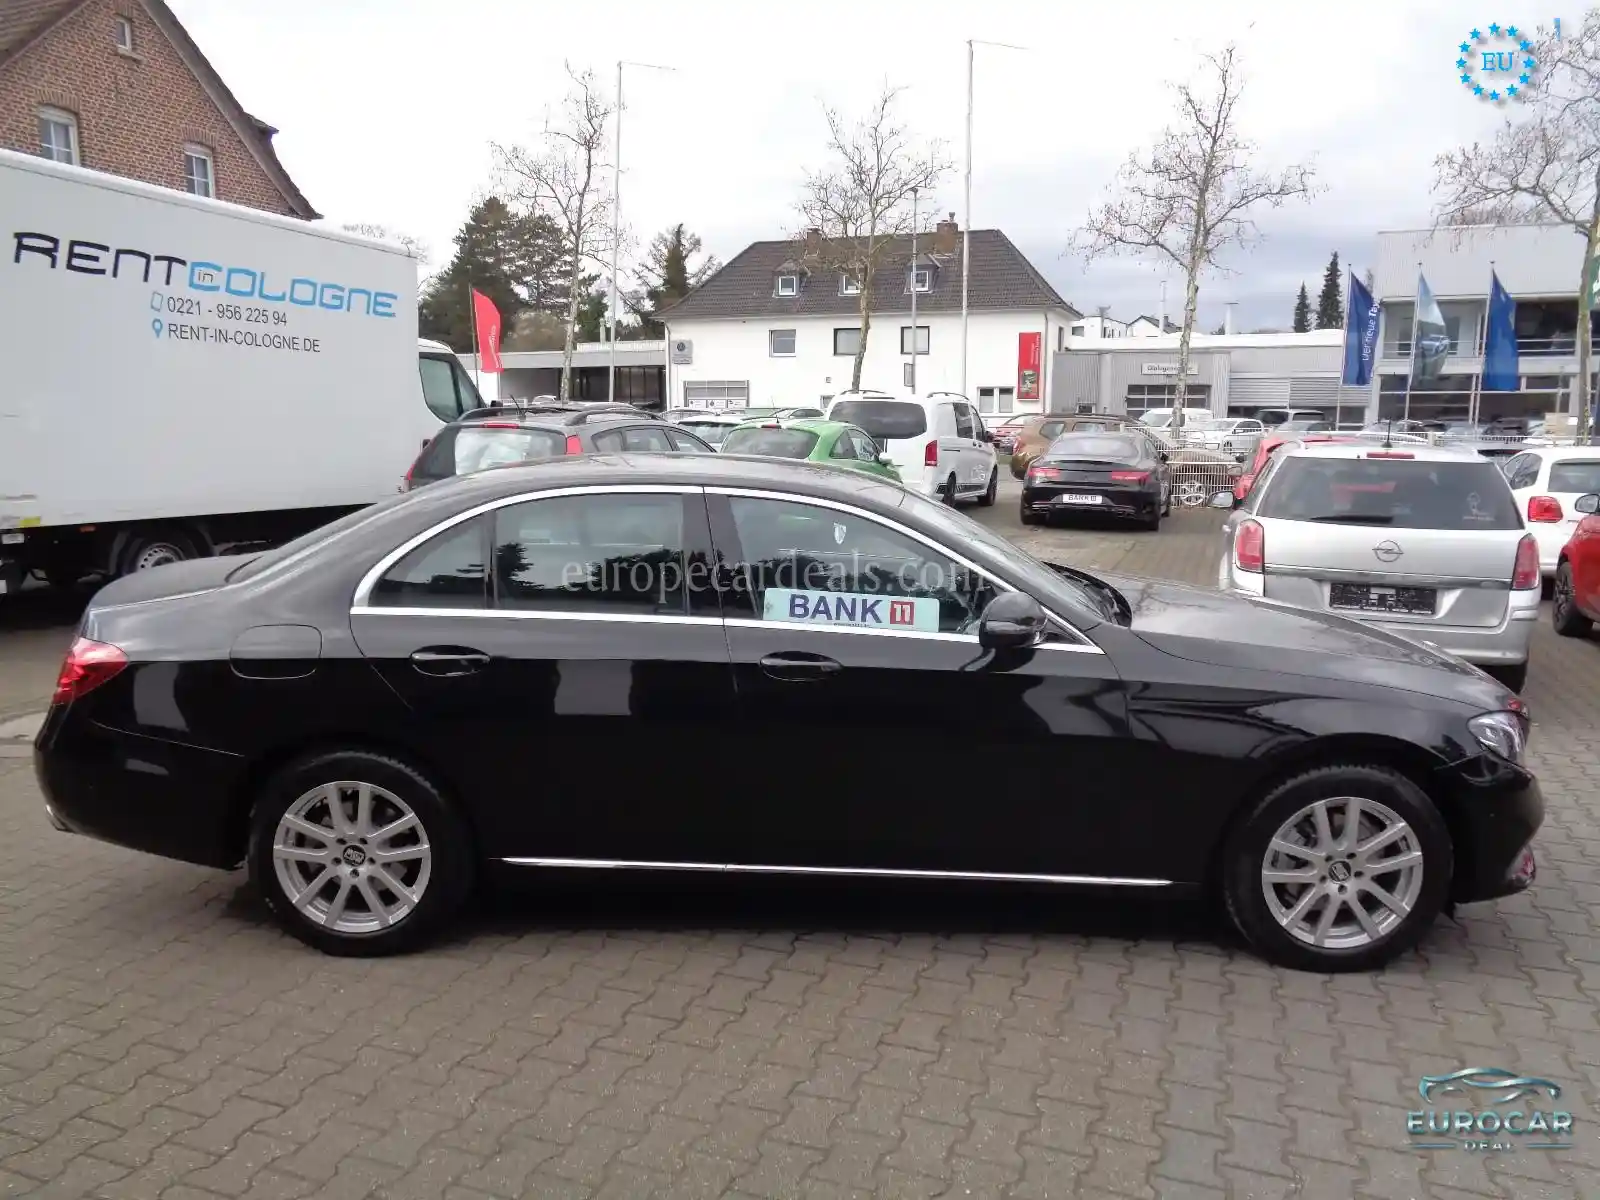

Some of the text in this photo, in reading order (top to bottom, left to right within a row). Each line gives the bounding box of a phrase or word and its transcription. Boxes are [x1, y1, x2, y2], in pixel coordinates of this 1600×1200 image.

[13, 231, 398, 317] RENT in COLOGNE
[167, 296, 201, 316] 0221
[216, 303, 242, 321] 956
[245, 307, 269, 324] 225
[272, 311, 288, 326] 94
[168, 322, 321, 353] RENT-IN-COLOGNE.DE
[788, 593, 883, 624] BANK
